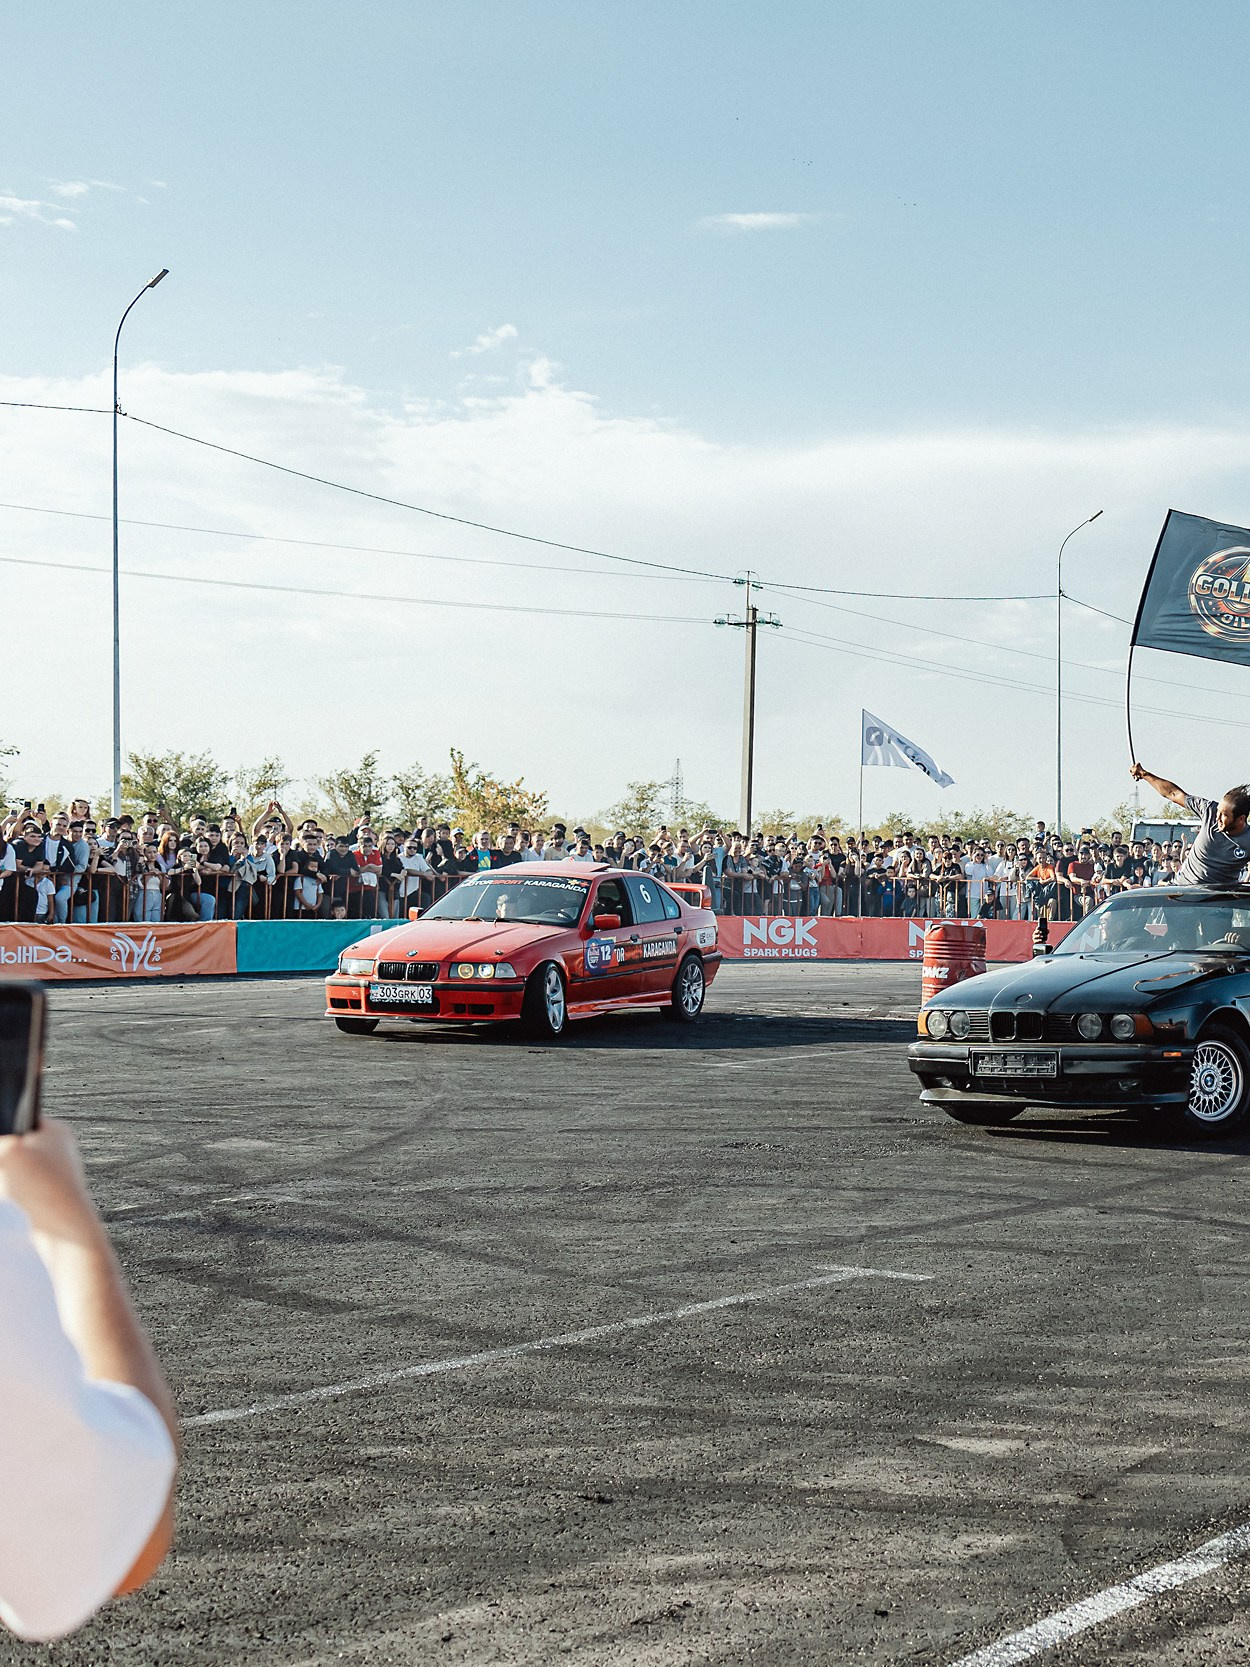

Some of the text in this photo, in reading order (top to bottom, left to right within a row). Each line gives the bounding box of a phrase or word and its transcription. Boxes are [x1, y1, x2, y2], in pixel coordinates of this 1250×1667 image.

[1221, 614, 1250, 628] OIL
[523, 880, 587, 894] KARAGANDA
[639, 884, 651, 904] 6
[743, 917, 818, 946] NGK
[600, 945, 611, 961] 12
[743, 948, 818, 957] SPARK PLUGS
[418, 988, 432, 1000] 03
